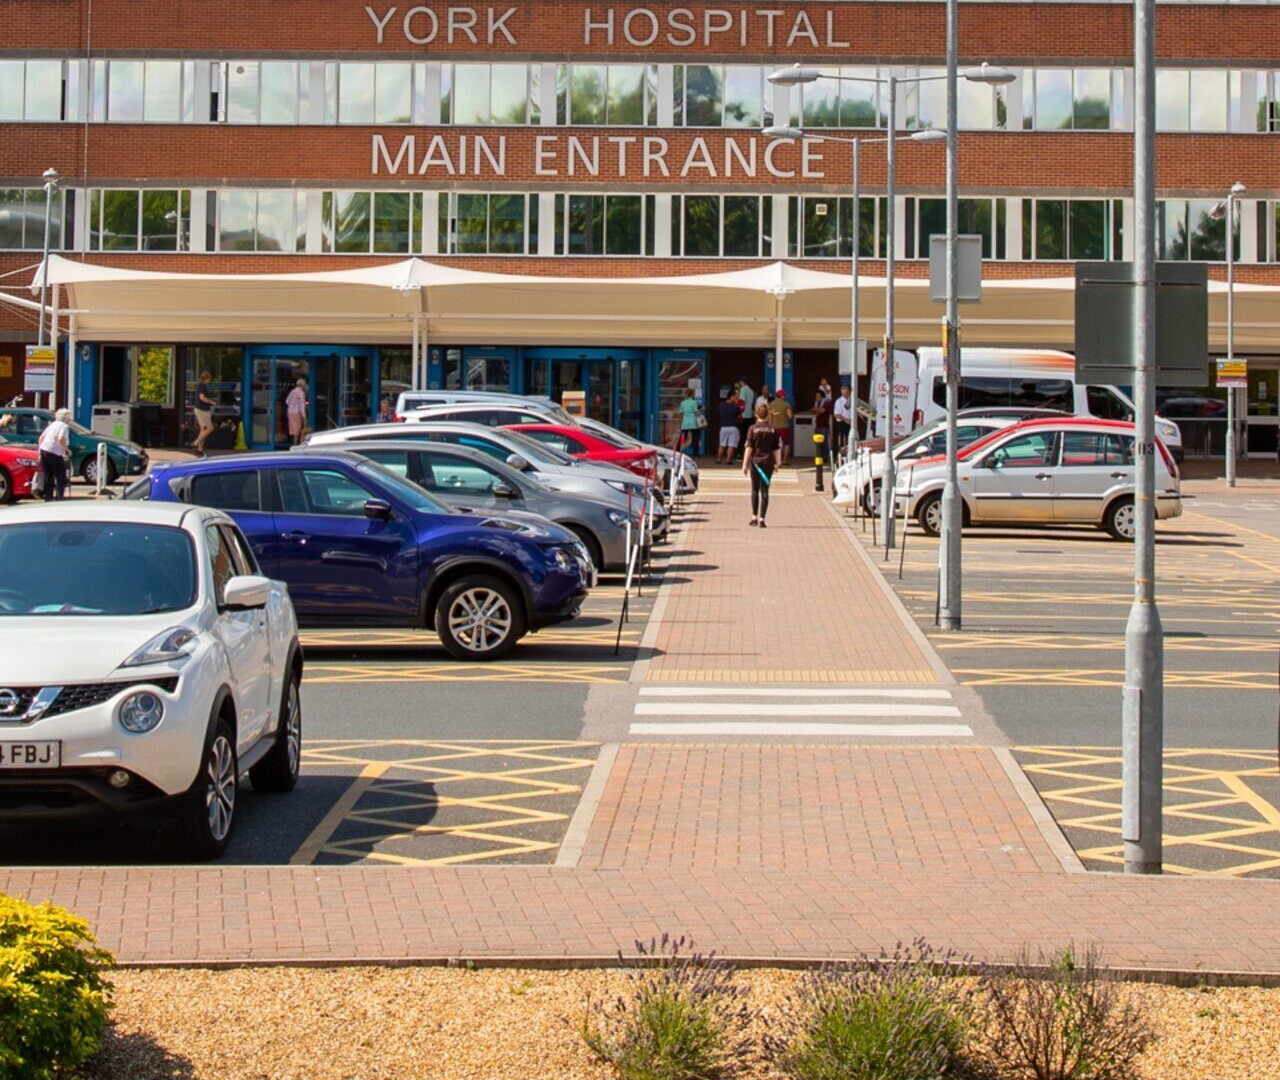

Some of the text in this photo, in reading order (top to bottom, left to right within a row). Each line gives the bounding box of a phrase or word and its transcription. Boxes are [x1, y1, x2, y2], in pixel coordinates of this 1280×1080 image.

[365, 6, 851, 48] YORK HOSPITAL
[372, 134, 826, 178] MAIN ENTRANCE
[11, 744, 51, 764] FBJ
